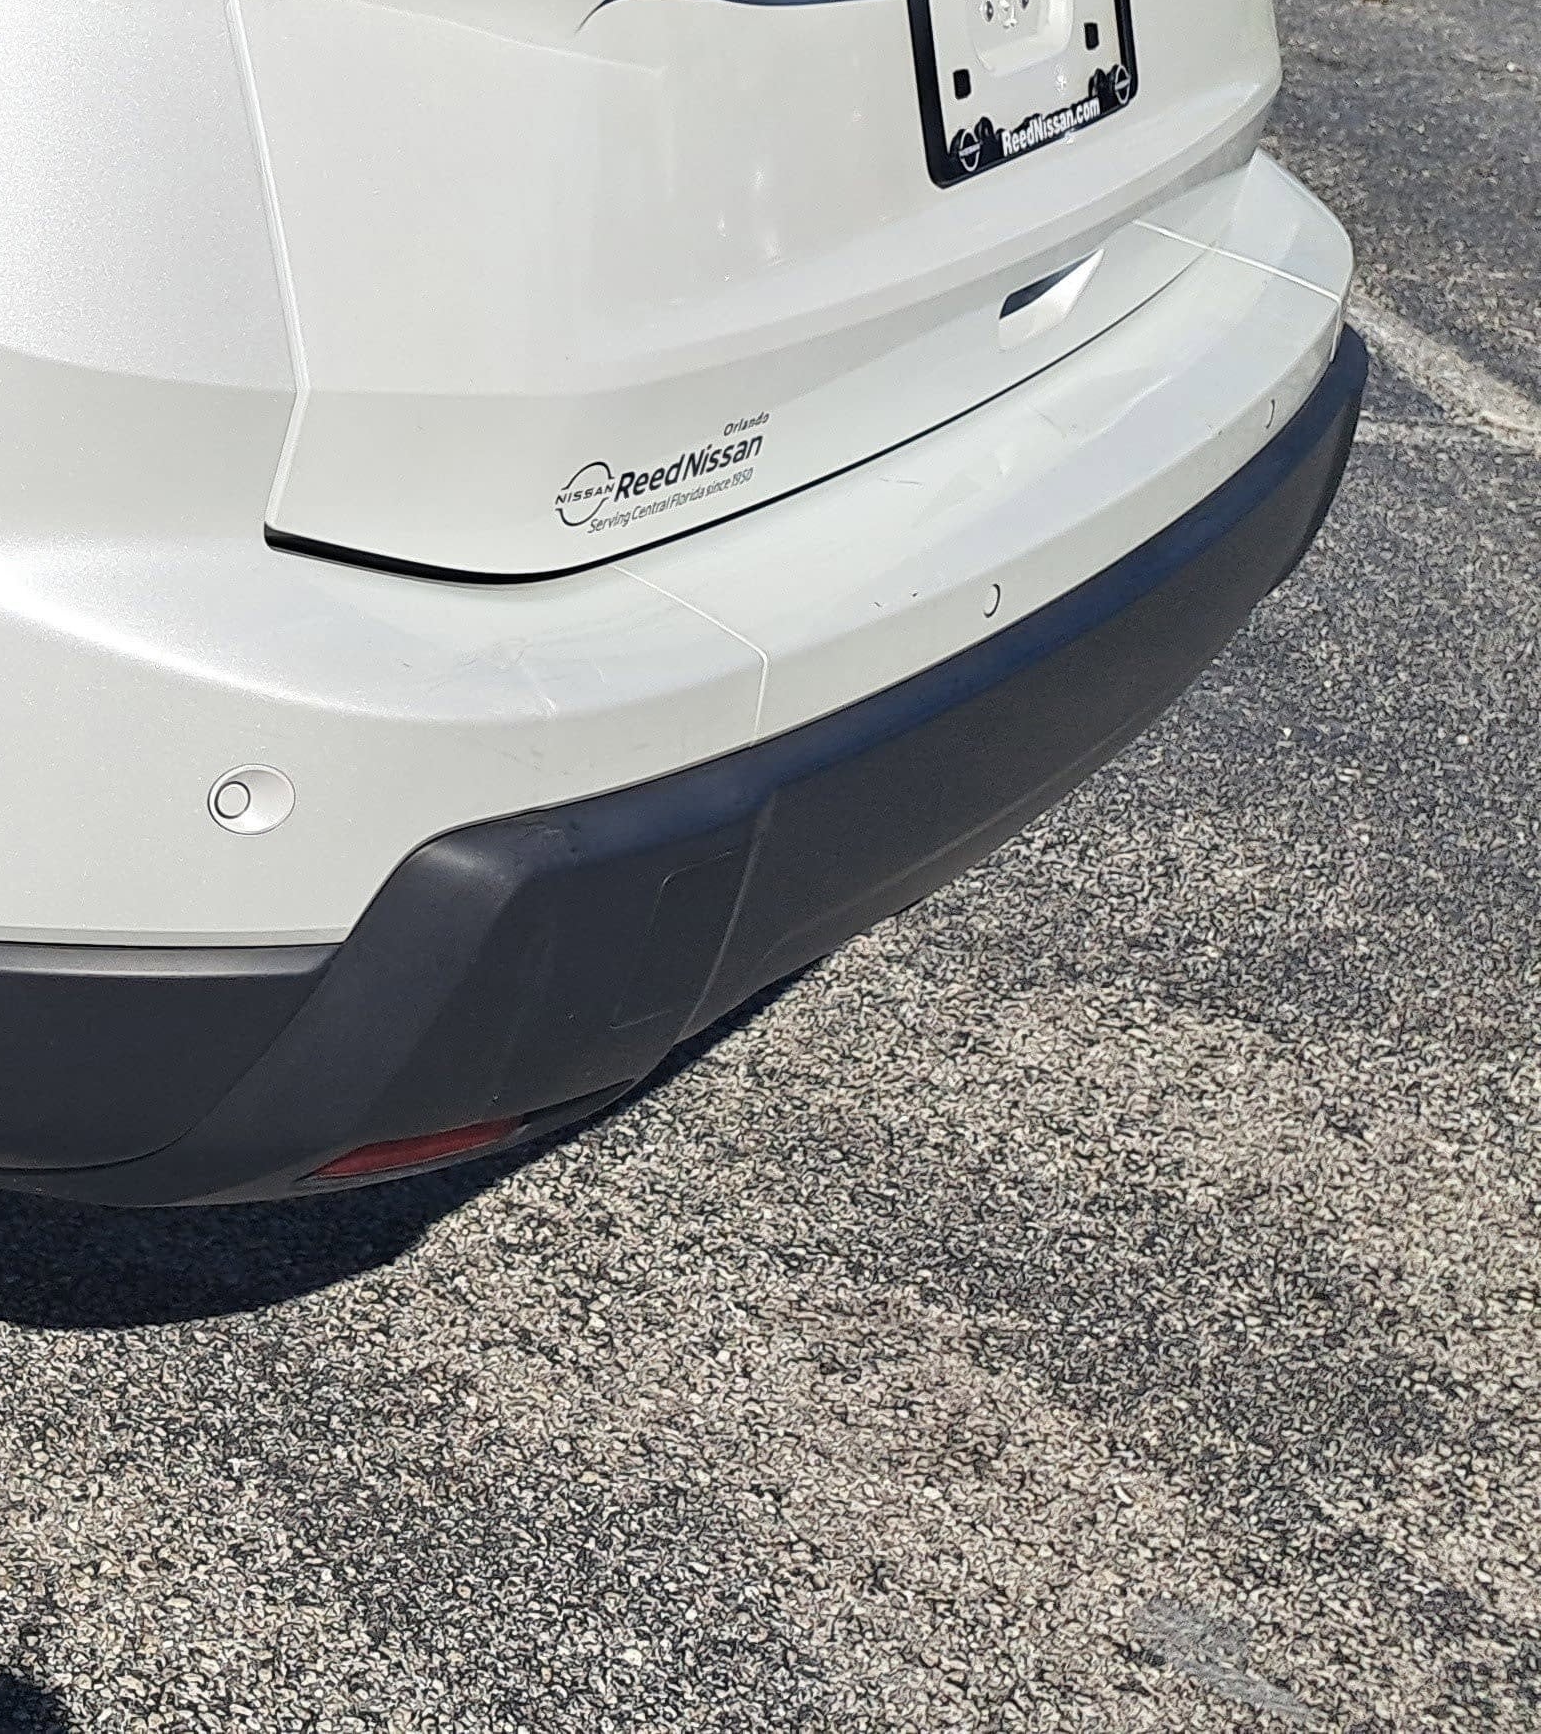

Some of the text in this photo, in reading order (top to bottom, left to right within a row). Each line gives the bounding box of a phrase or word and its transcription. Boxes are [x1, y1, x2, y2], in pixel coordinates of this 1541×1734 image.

[1001, 97, 1101, 157] ReedNissan.com
[723, 412, 769, 437] Orlando
[555, 482, 615, 505] NISSAN
[587, 511, 631, 534] Serving
[631, 497, 671, 521] Central
[669, 487, 706, 509] Florida
[705, 478, 731, 497] since
